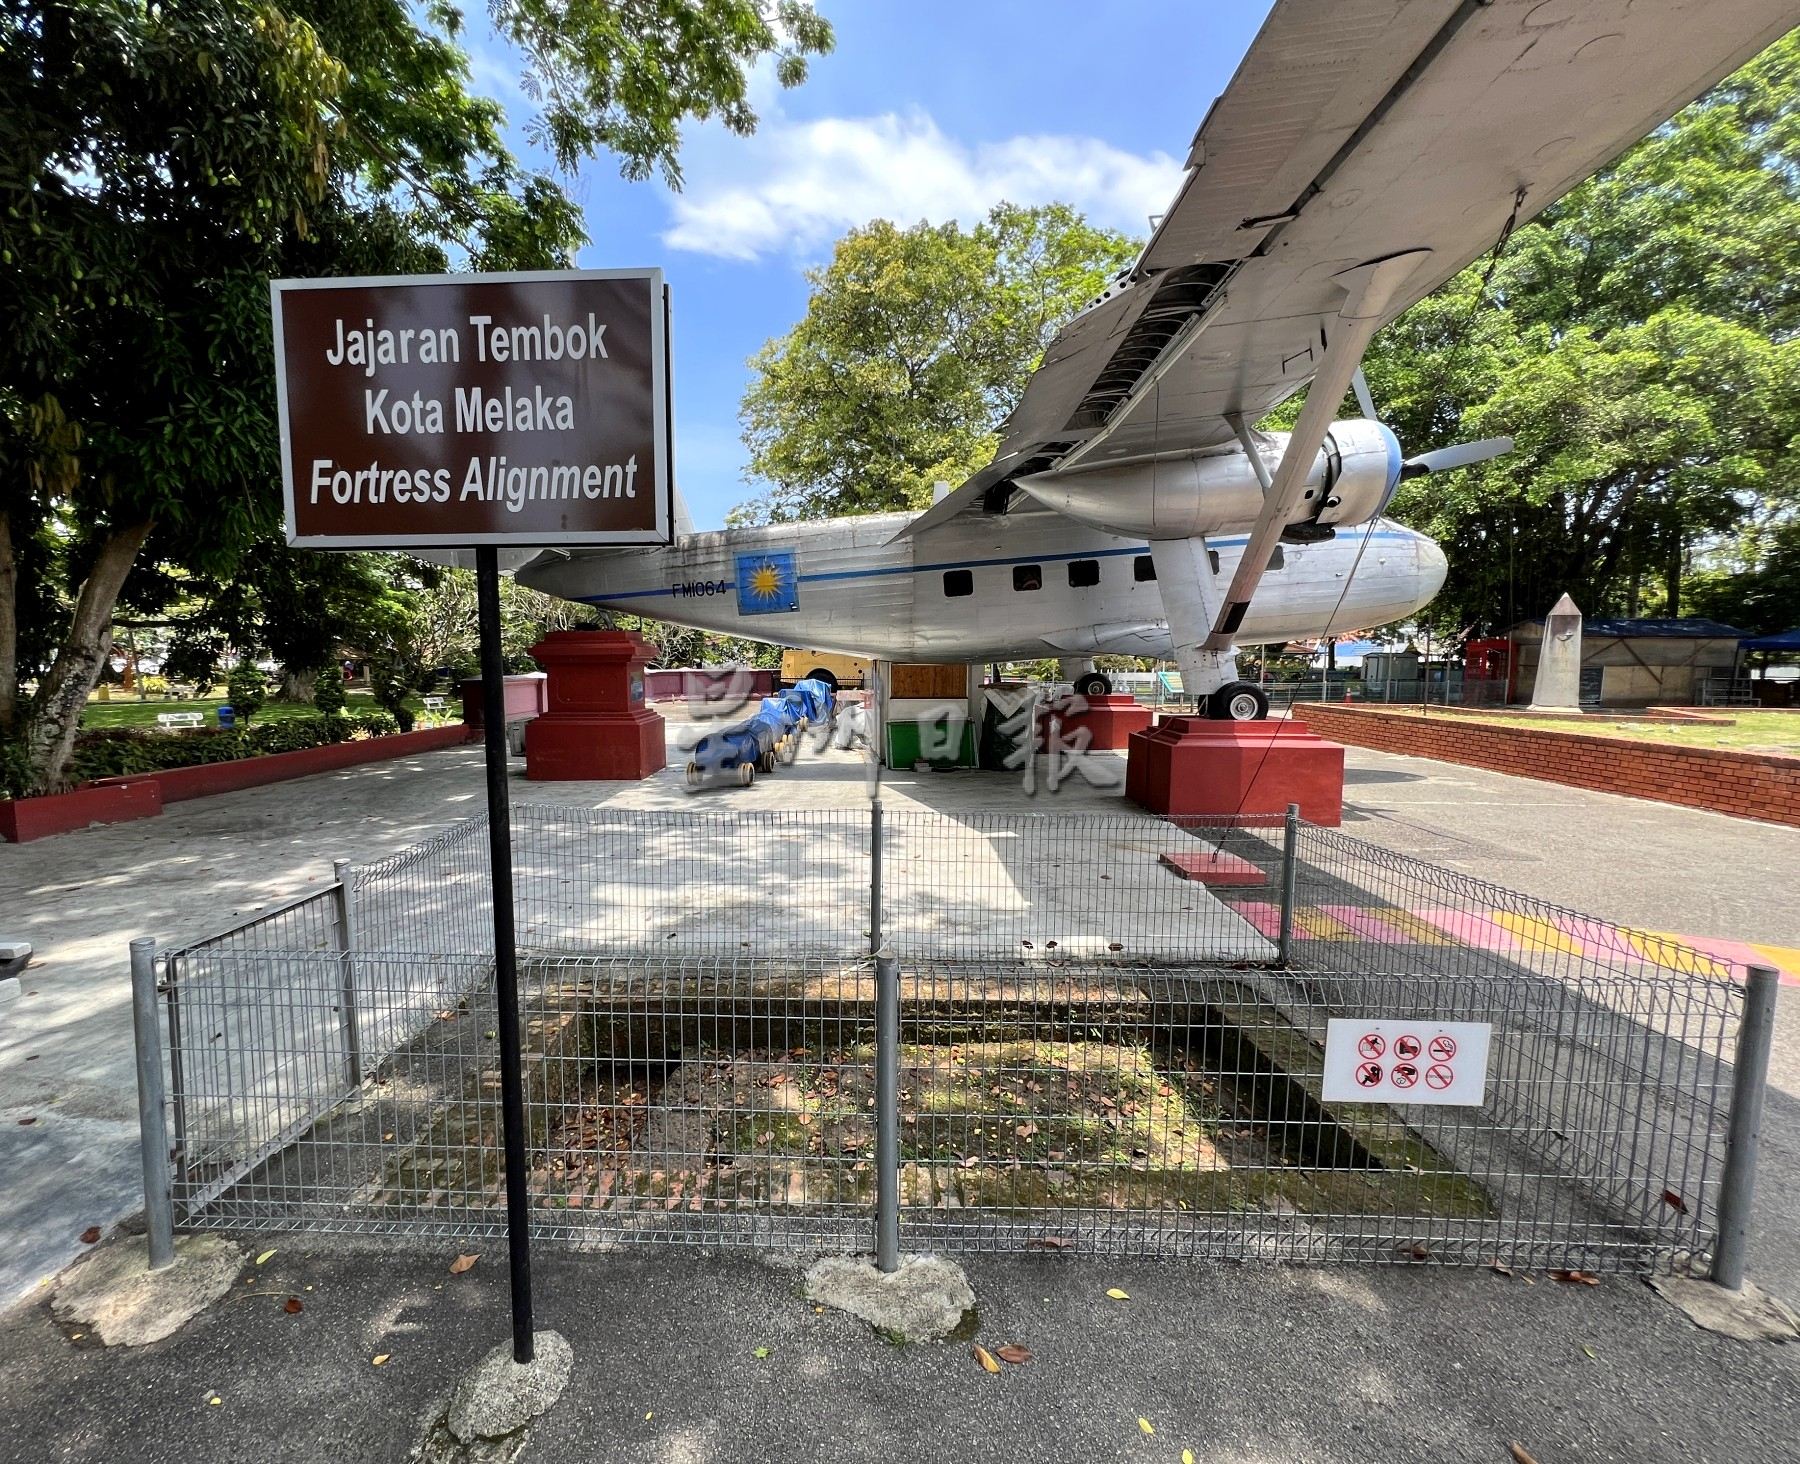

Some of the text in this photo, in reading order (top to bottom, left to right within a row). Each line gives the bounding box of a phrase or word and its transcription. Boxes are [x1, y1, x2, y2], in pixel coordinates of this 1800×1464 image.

[326, 312, 609, 377] Jajaran Tembok
[364, 385, 575, 435] Kota Melaka
[310, 454, 638, 513] Fortress Alignment
